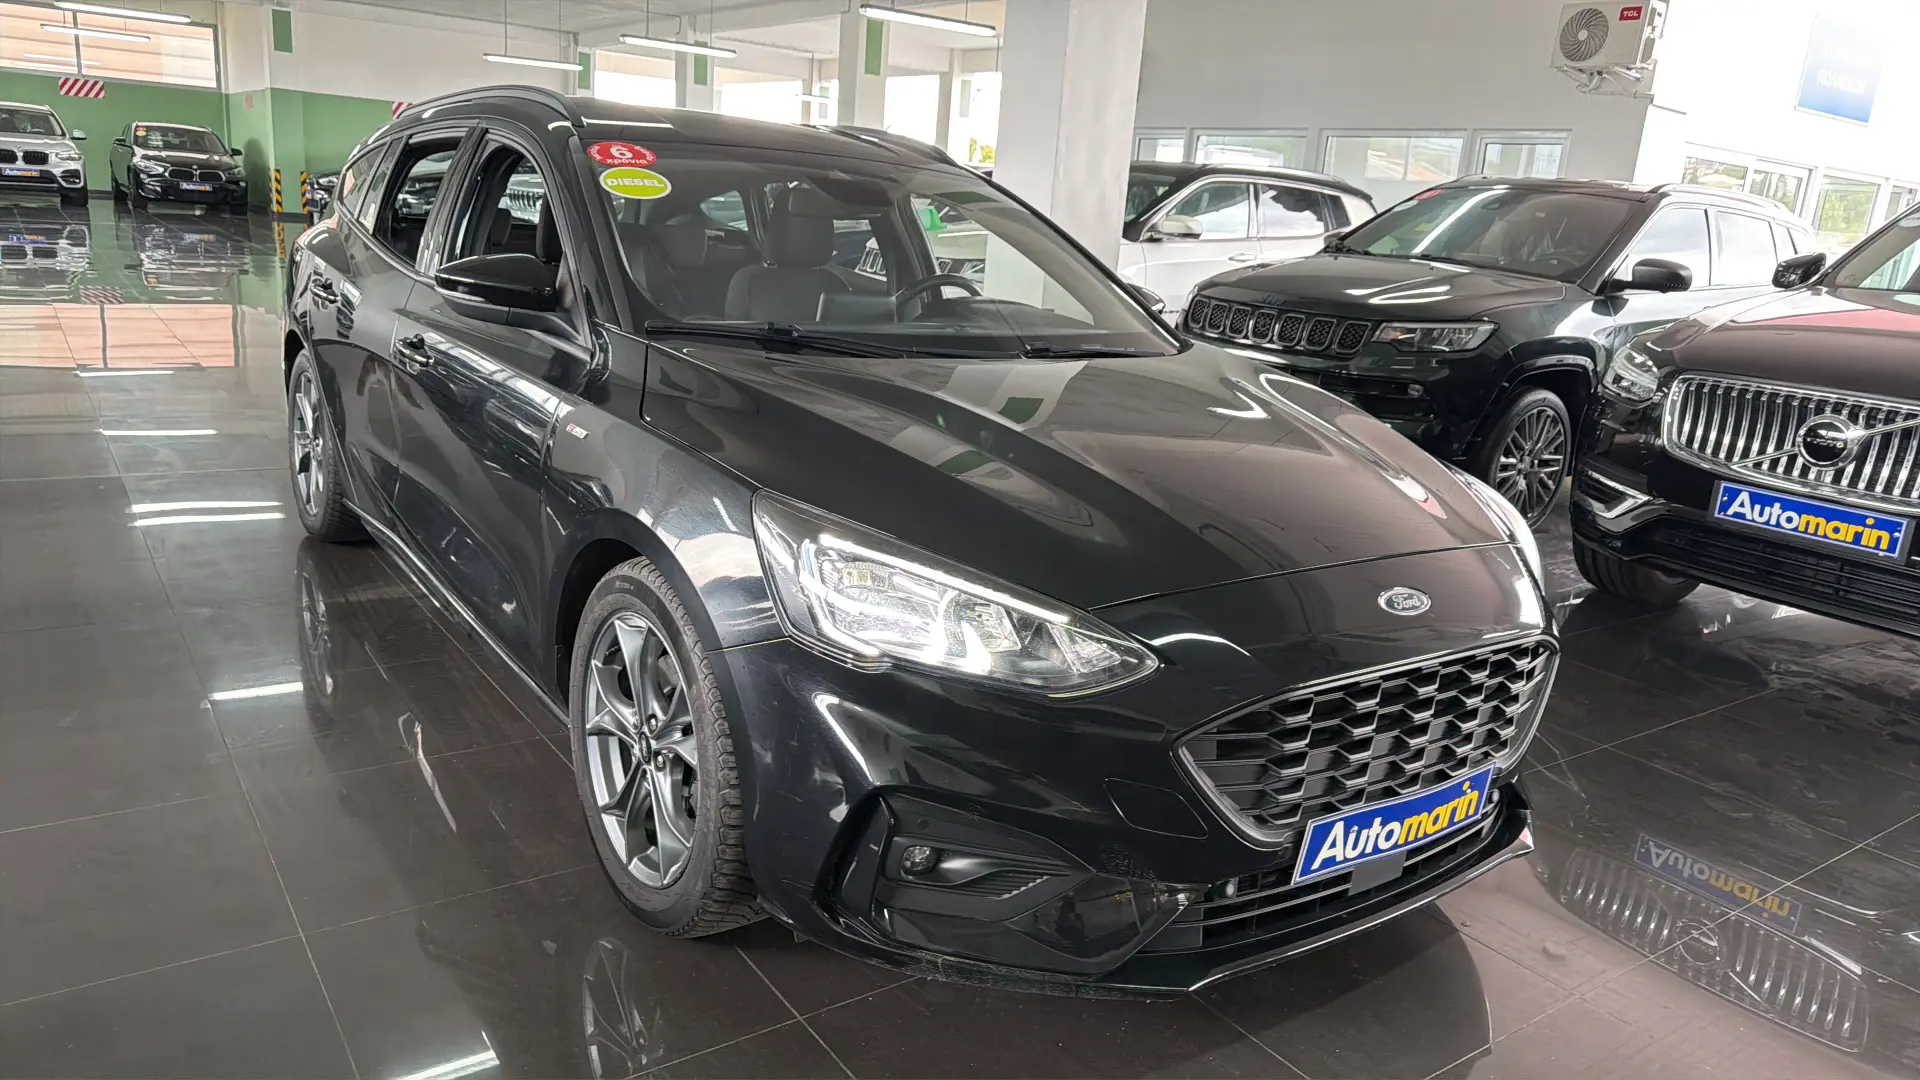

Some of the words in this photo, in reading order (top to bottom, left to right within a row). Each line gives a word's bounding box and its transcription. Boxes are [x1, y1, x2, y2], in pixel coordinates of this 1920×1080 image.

[610, 145, 633, 159] 6
[606, 178, 665, 187] DIESEL
[1726, 491, 1891, 550] Automarin
[1392, 594, 1421, 609] Ford
[1310, 781, 1479, 871] Automarin
